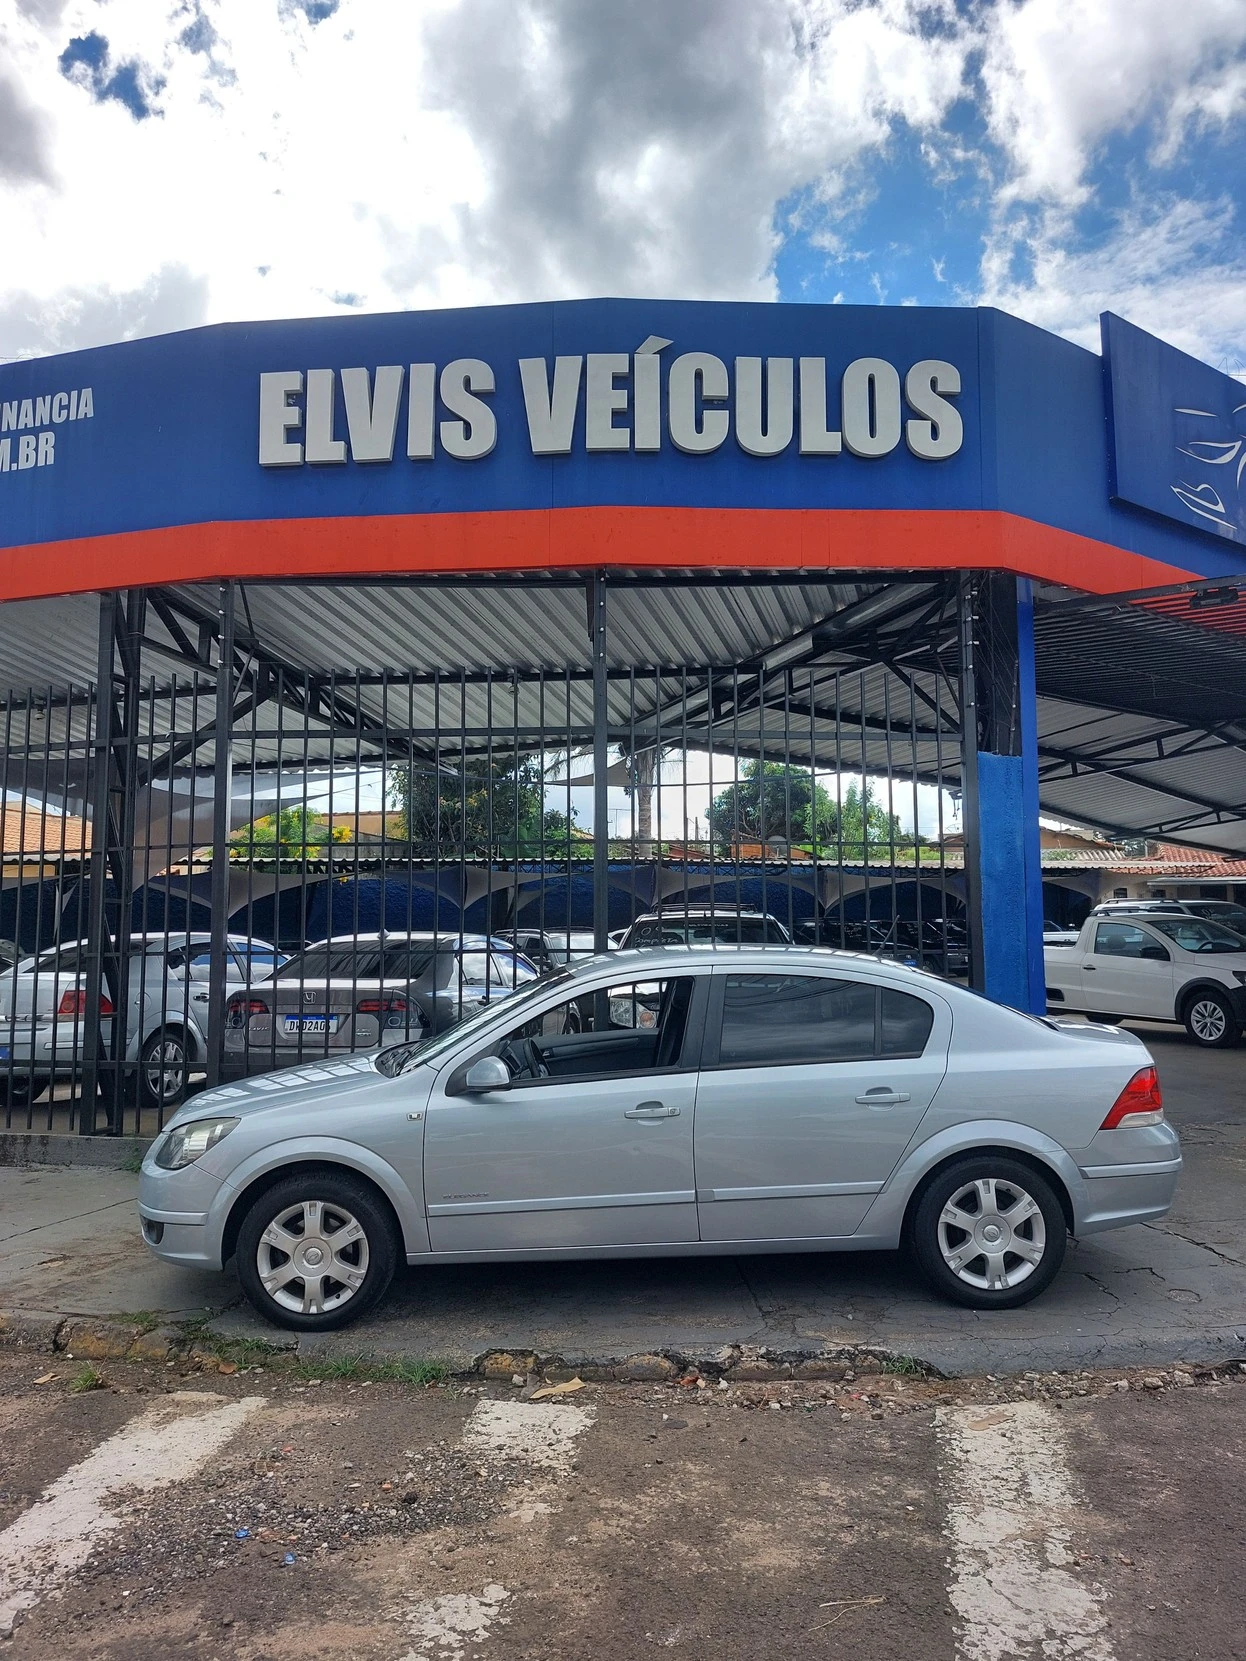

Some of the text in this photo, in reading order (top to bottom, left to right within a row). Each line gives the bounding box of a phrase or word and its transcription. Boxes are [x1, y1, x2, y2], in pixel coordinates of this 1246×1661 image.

[0, 388, 94, 432] NANCIA
[259, 335, 963, 466] ELVIS VEÍCULOS
